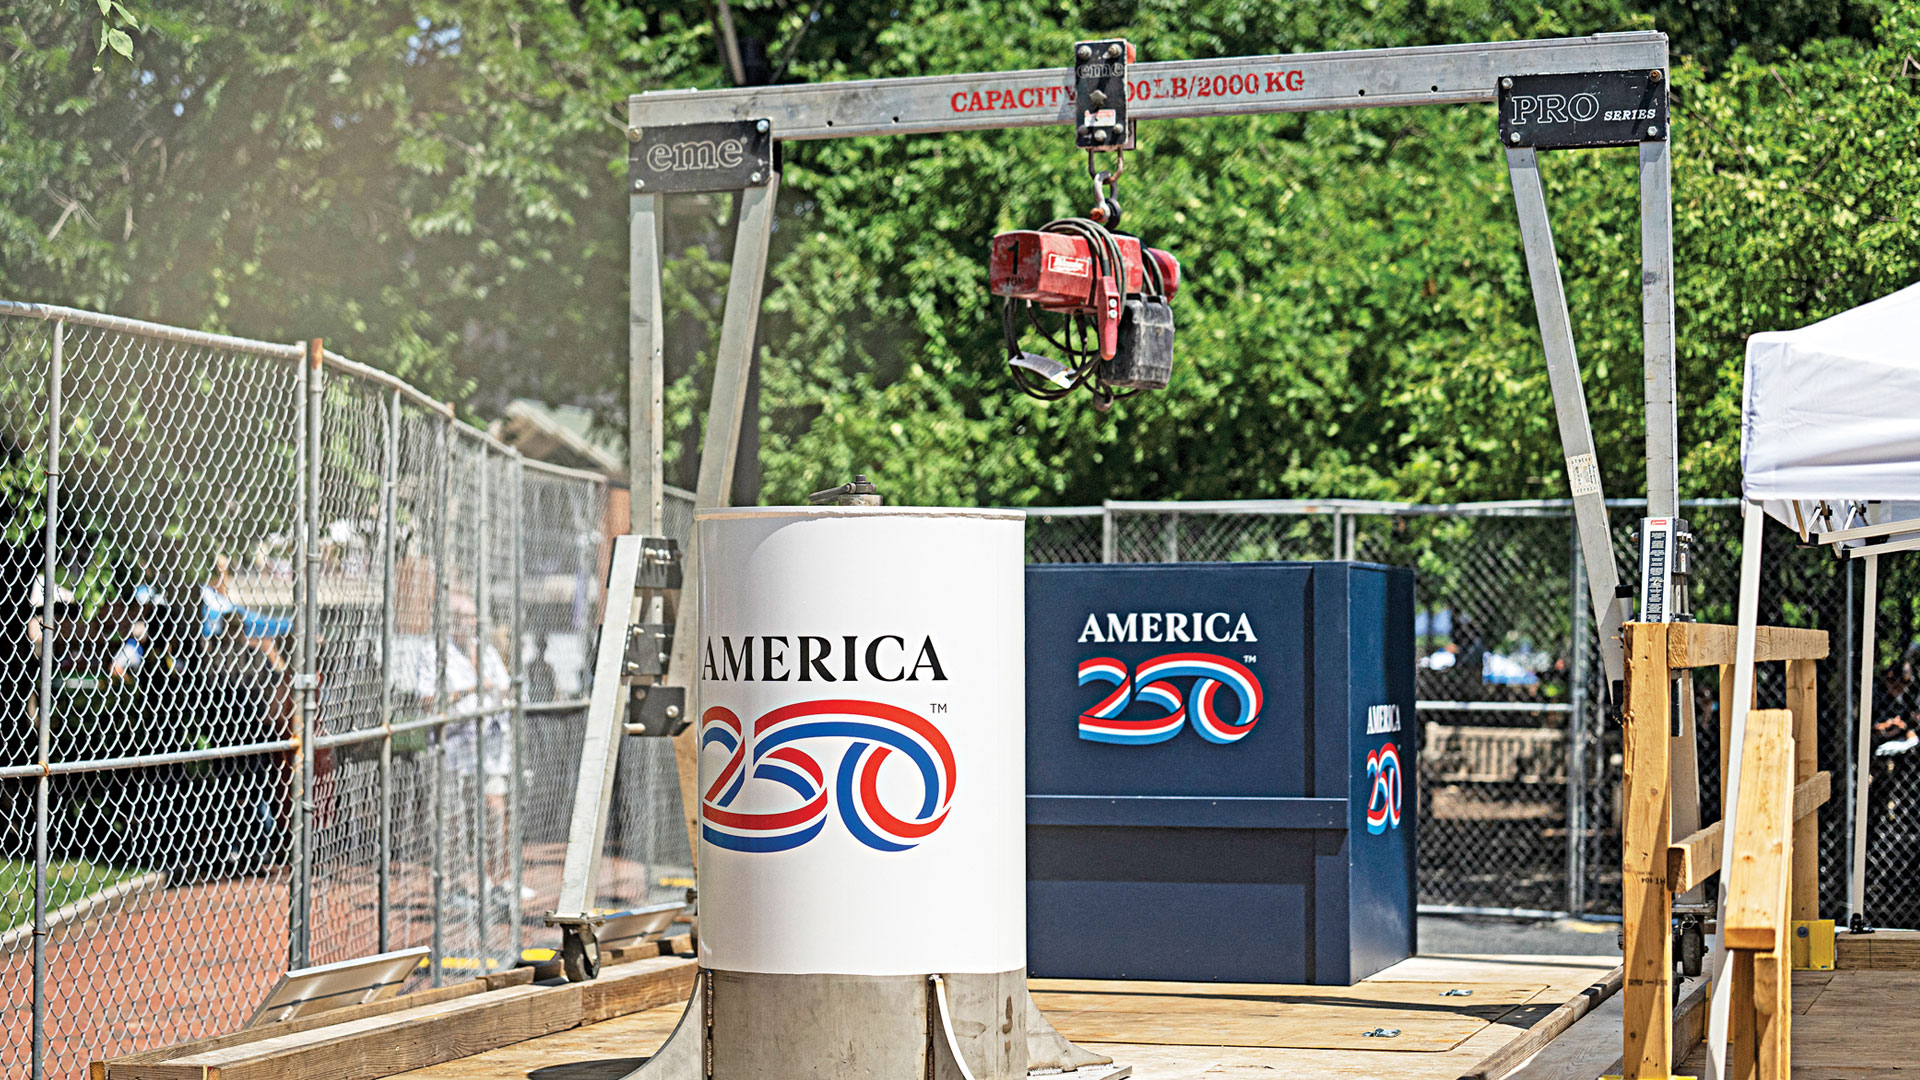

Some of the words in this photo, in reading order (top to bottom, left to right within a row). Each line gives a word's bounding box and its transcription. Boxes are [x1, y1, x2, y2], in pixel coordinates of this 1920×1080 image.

[1077, 63, 1124, 78] eme
[950, 86, 1077, 113] CAPACITY
[1127, 73, 1259, 102] 00LB/2000
[1264, 70, 1305, 93] KG
[1511, 93, 1600, 125] PRO
[1604, 109, 1656, 122] SERIES
[646, 139, 744, 172] eme
[1007, 240, 1020, 275] 1
[1005, 276, 1025, 287] TON
[1077, 612, 1258, 643] AMERICA
[701, 634, 949, 682] AMERICA
[929, 703, 948, 714] TM
[1078, 652, 1264, 745] 250
[1366, 704, 1401, 735] AMERICA
[702, 699, 957, 853] 250
[1367, 742, 1402, 836] 250
